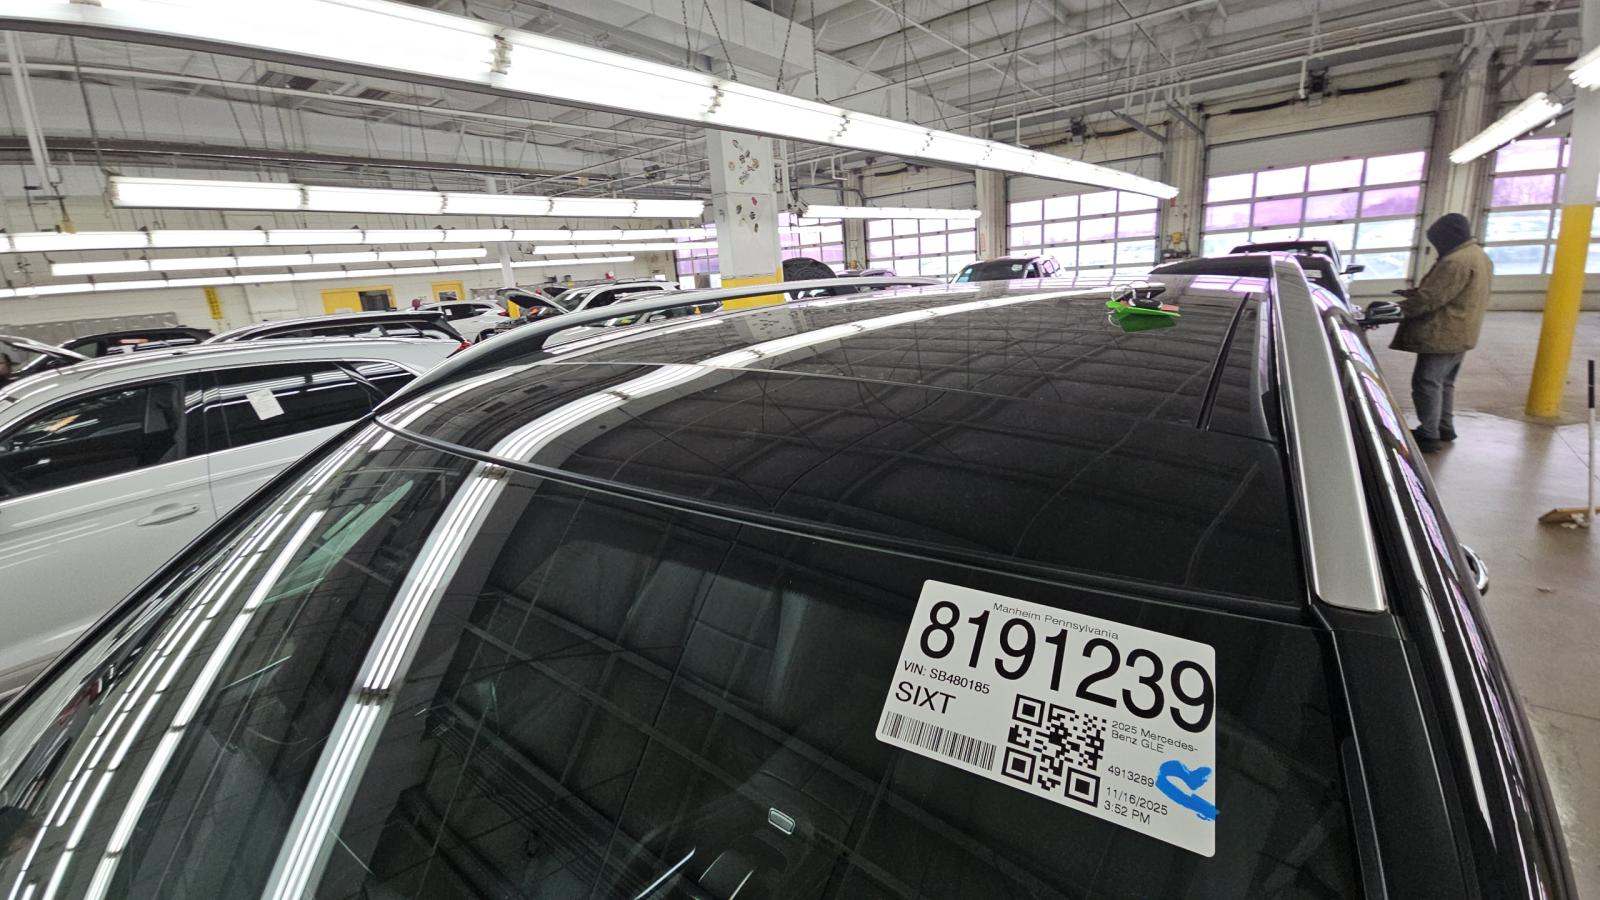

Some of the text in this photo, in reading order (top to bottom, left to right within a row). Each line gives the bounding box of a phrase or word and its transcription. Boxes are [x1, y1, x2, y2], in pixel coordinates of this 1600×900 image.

[993, 602, 1119, 640] Manheim Pennsylvania
[904, 661, 990, 694] VIN: SB480185
[920, 601, 1215, 733] 8191239
[895, 681, 956, 714] SIXT
[1111, 720, 1198, 752] 2025 Mercedes-
[1111, 730, 1165, 753] Benz GLE
[1103, 800, 1151, 825] 3:52 PM
[1106, 786, 1168, 815] 11/16/2025
